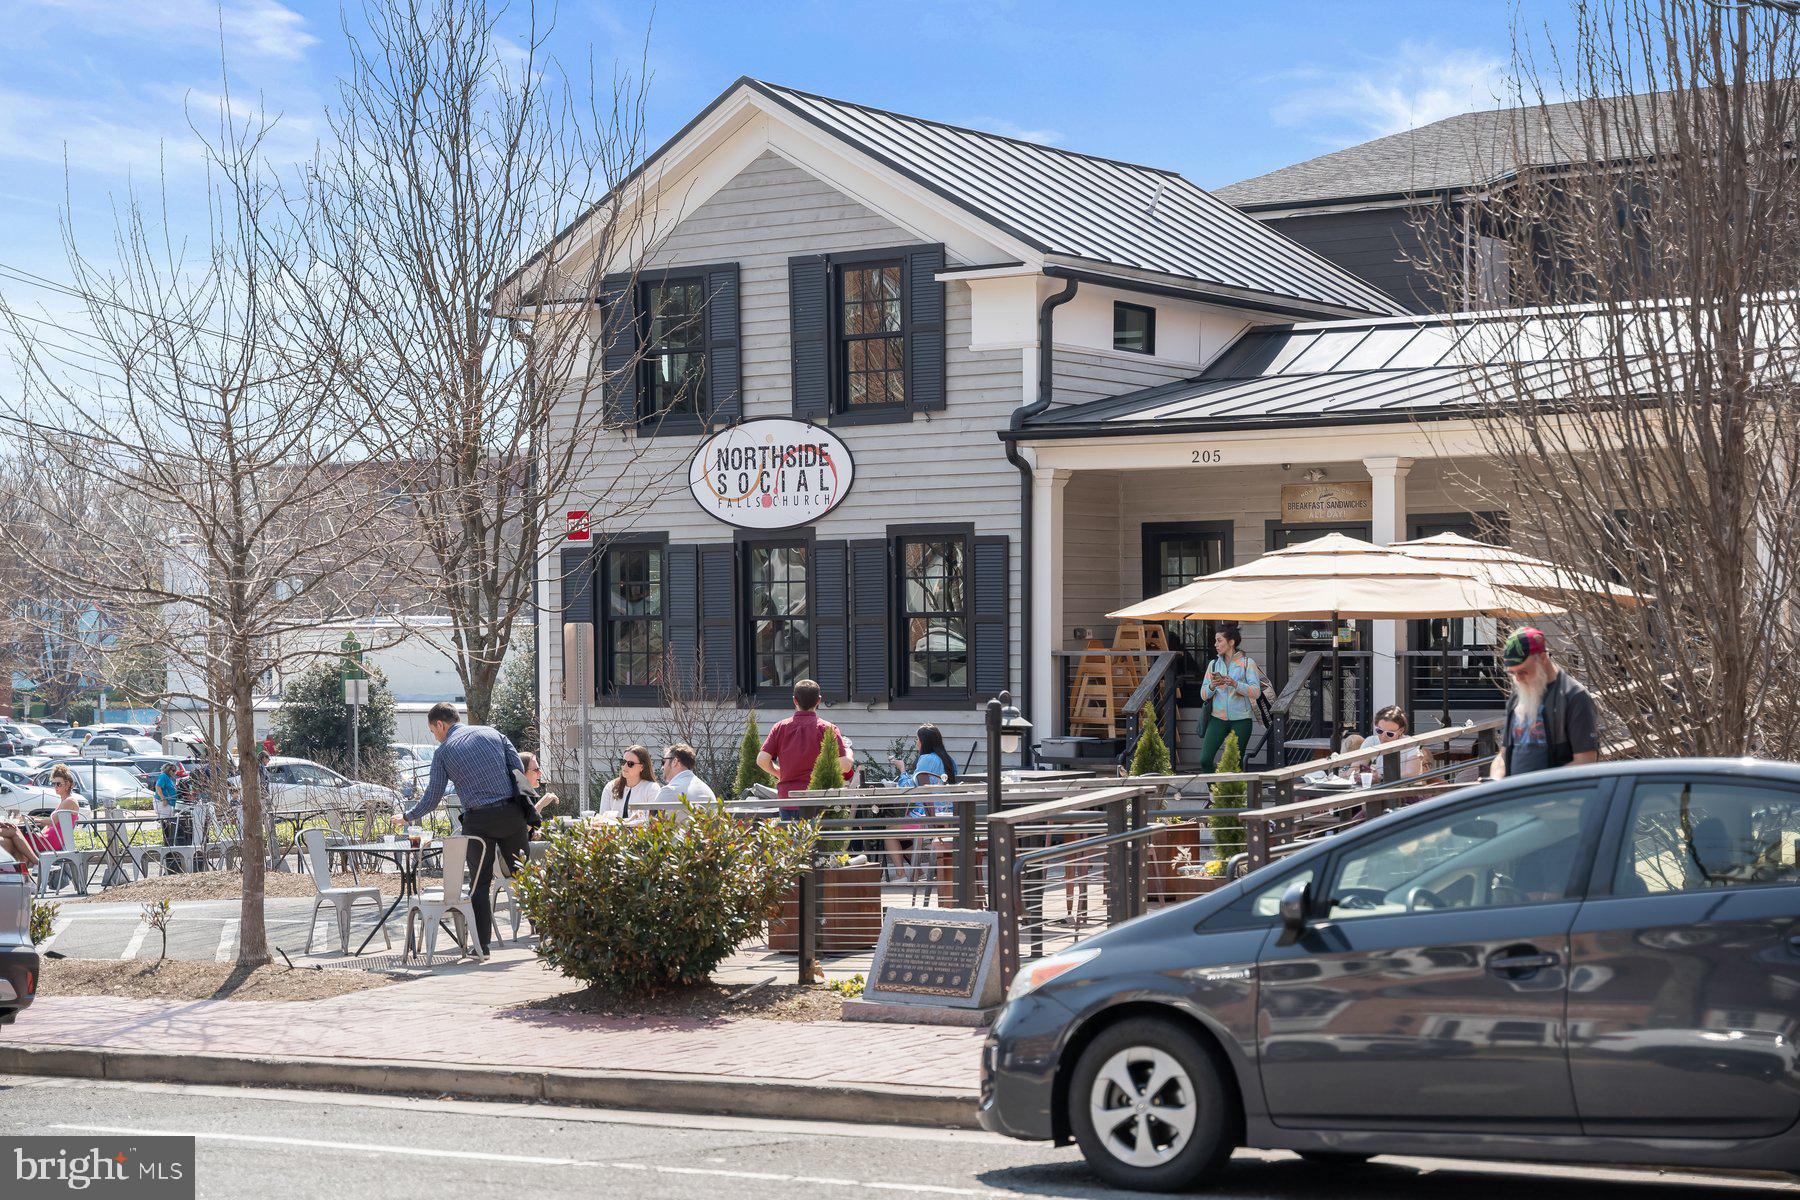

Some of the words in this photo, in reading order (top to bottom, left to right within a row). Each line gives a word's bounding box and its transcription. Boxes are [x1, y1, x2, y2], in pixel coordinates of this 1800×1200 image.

[717, 443, 829, 471] NORTHSIDE
[1192, 450, 1221, 463] 205
[717, 469, 829, 495] SOCIAL
[718, 496, 760, 509] FALLS
[772, 494, 830, 507] CHURCH
[1288, 501, 1325, 510] BREAKFAST
[1326, 500, 1367, 510] SANDWICHES
